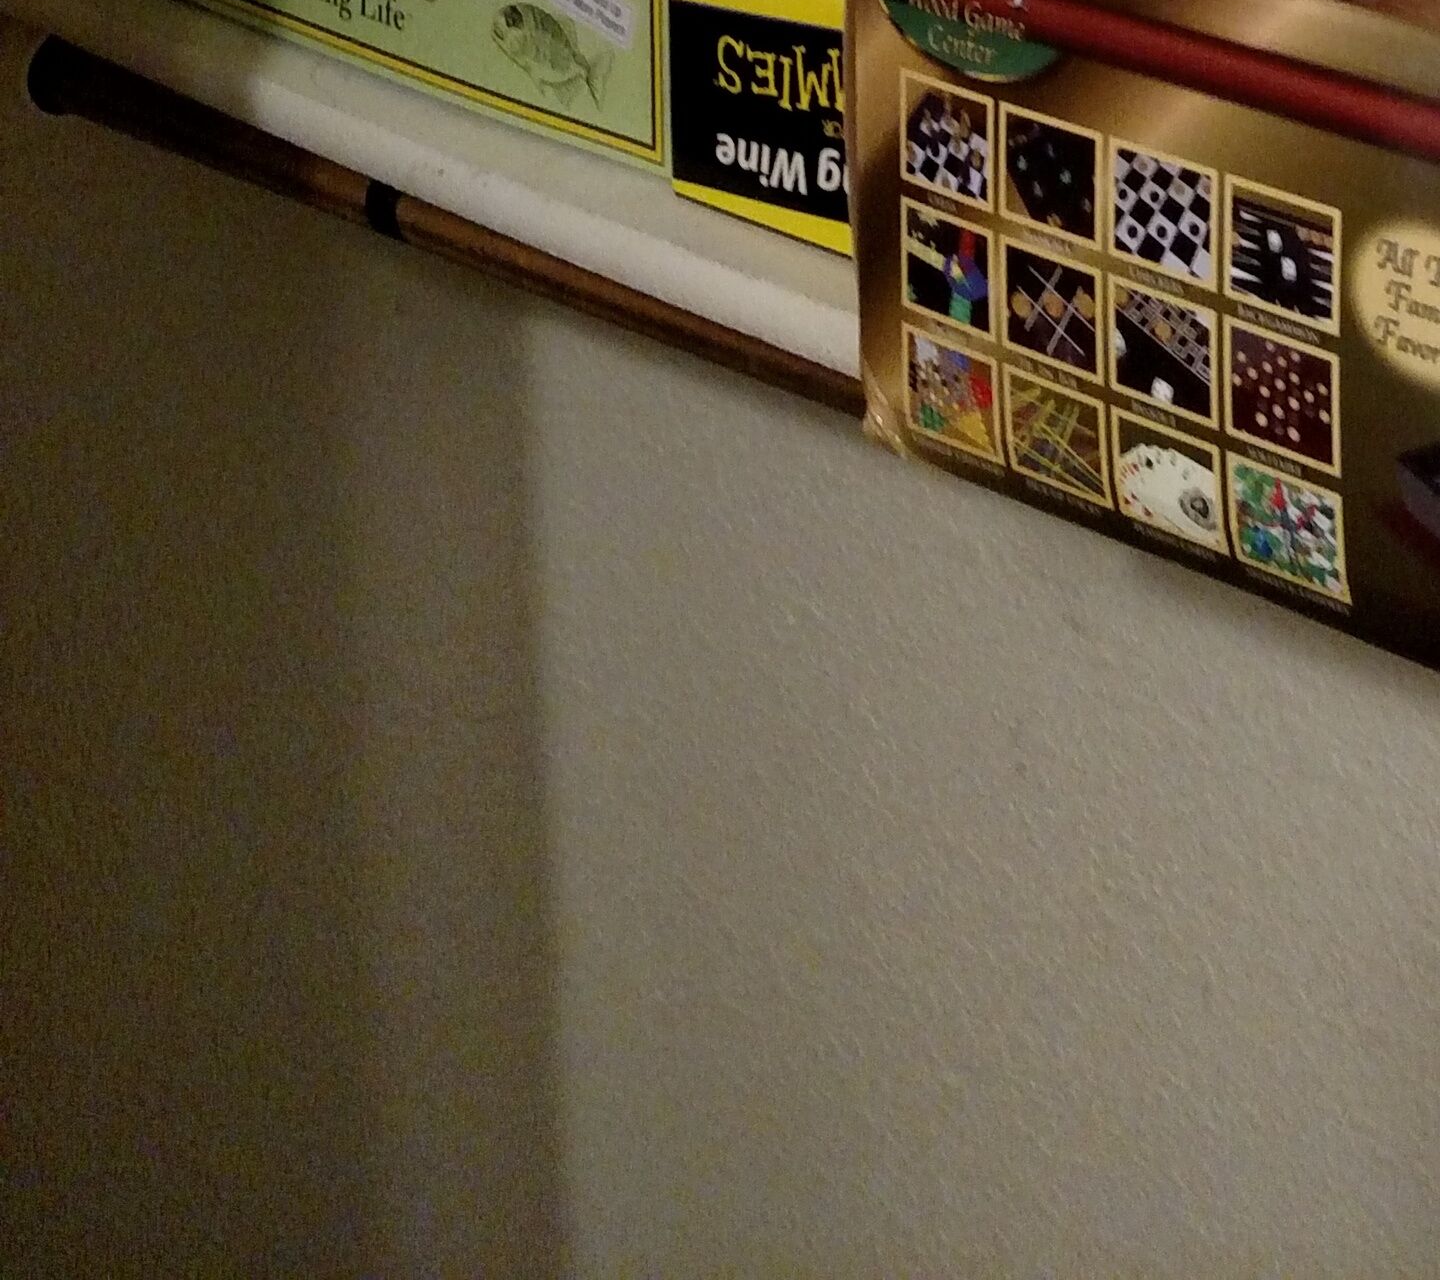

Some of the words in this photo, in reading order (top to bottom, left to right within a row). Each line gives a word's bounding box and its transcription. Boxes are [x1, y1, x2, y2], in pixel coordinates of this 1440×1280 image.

[964, 0, 1027, 42] Game
[927, 23, 998, 64] Center
[715, 132, 808, 196] Wine
[1376, 238, 1421, 280] All
